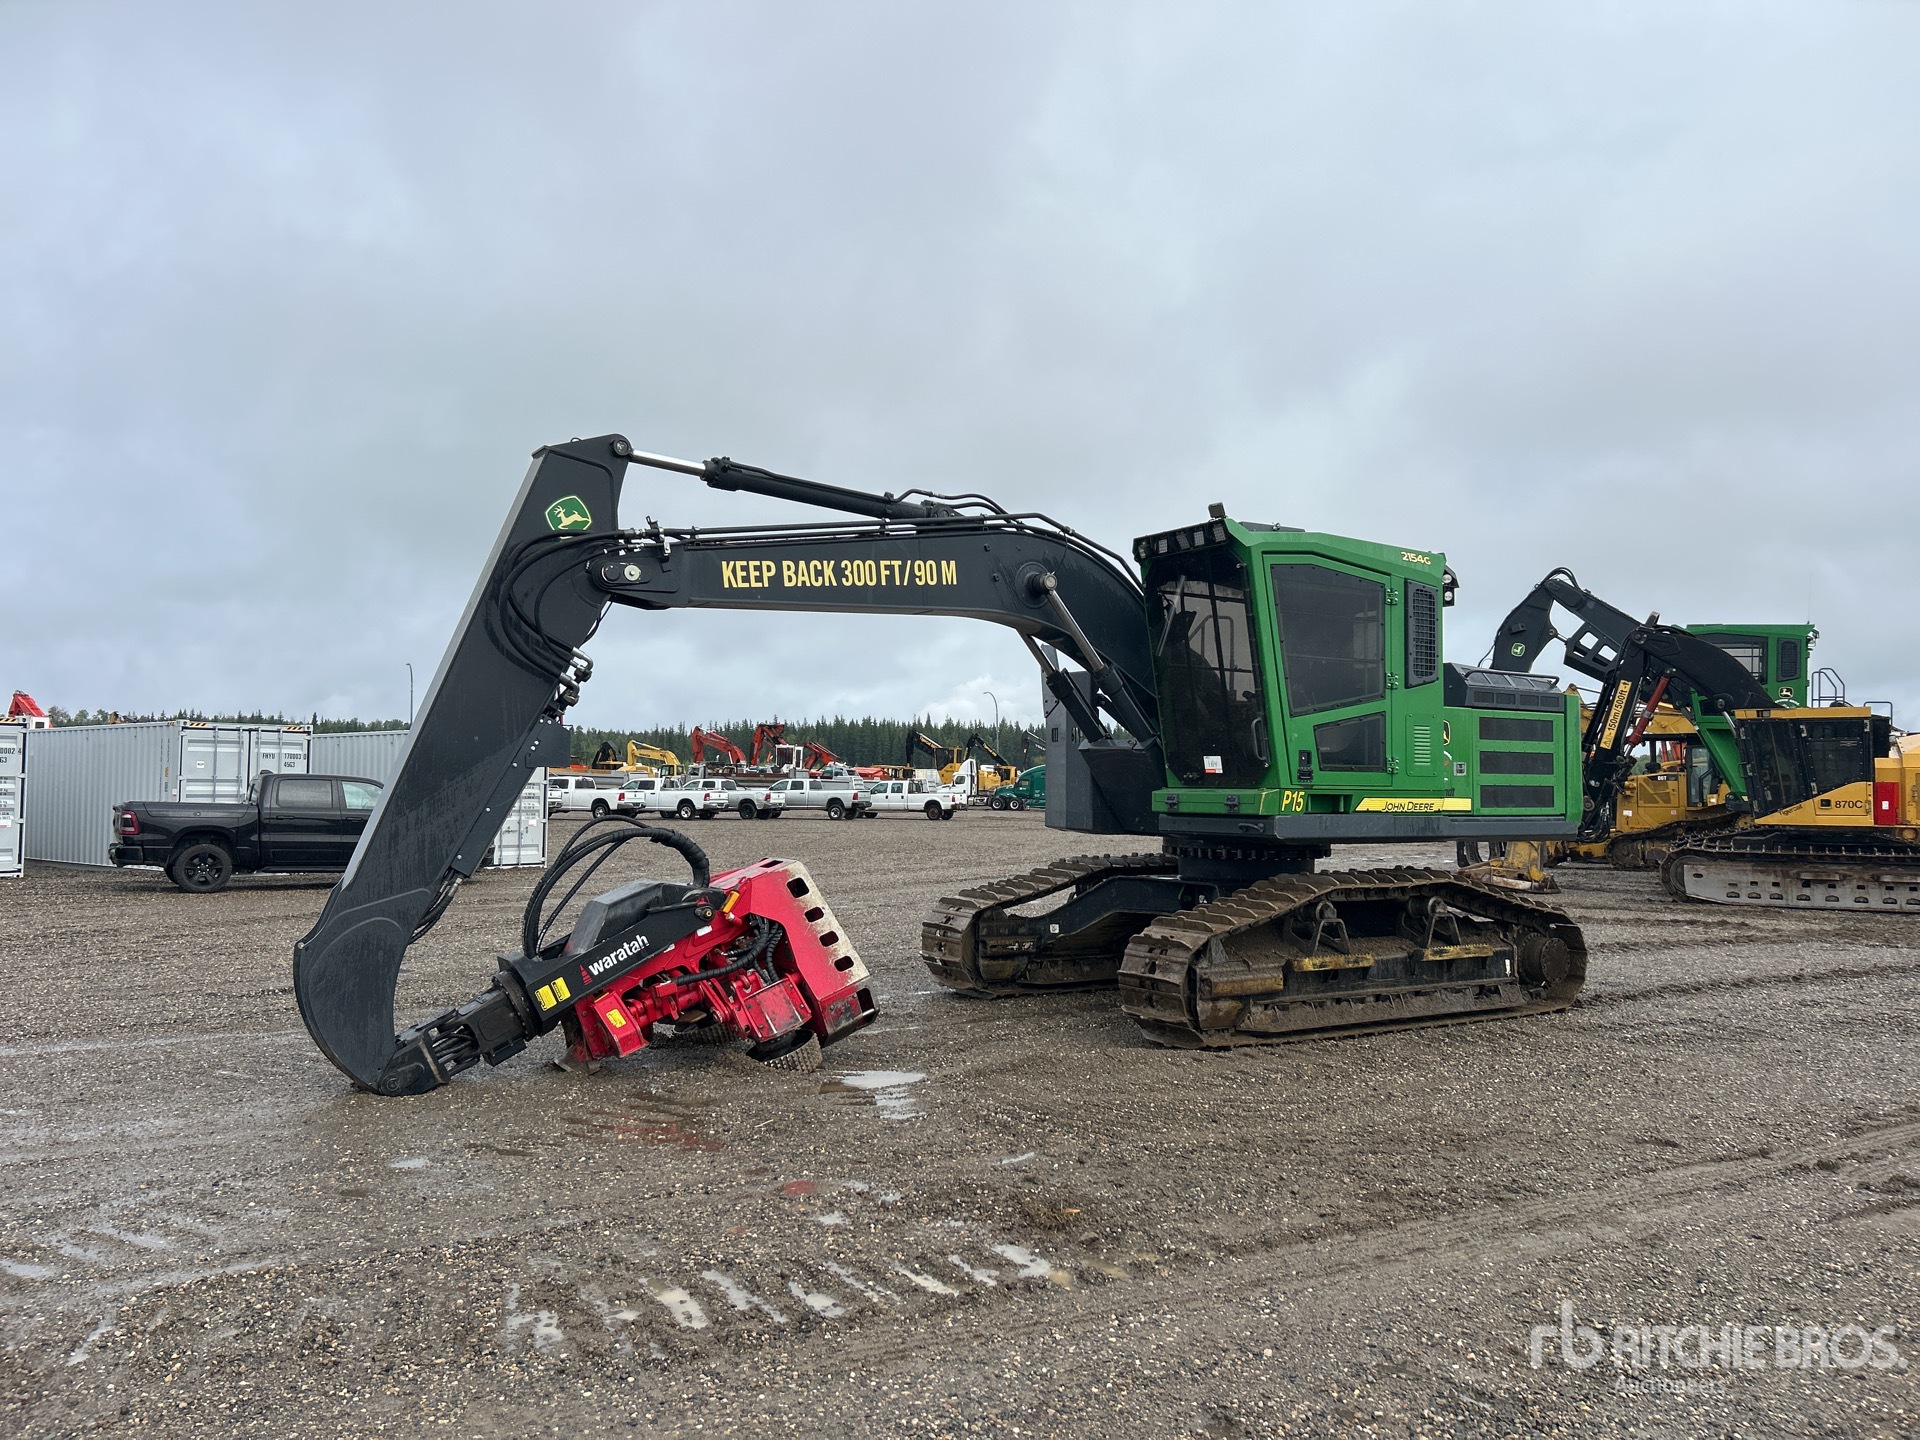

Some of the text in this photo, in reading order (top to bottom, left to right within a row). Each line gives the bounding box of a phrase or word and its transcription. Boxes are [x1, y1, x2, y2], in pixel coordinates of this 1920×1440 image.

[1400, 551, 1431, 565] 2154G
[721, 560, 776, 588] KEEP
[782, 560, 838, 587] BACK
[841, 560, 877, 586] 300
[941, 560, 957, 585] M
[1281, 790, 1306, 812] P15
[1382, 801, 1435, 811] JOHN DEERE
[1834, 800, 1863, 809] 870C
[588, 934, 650, 976] waratah
